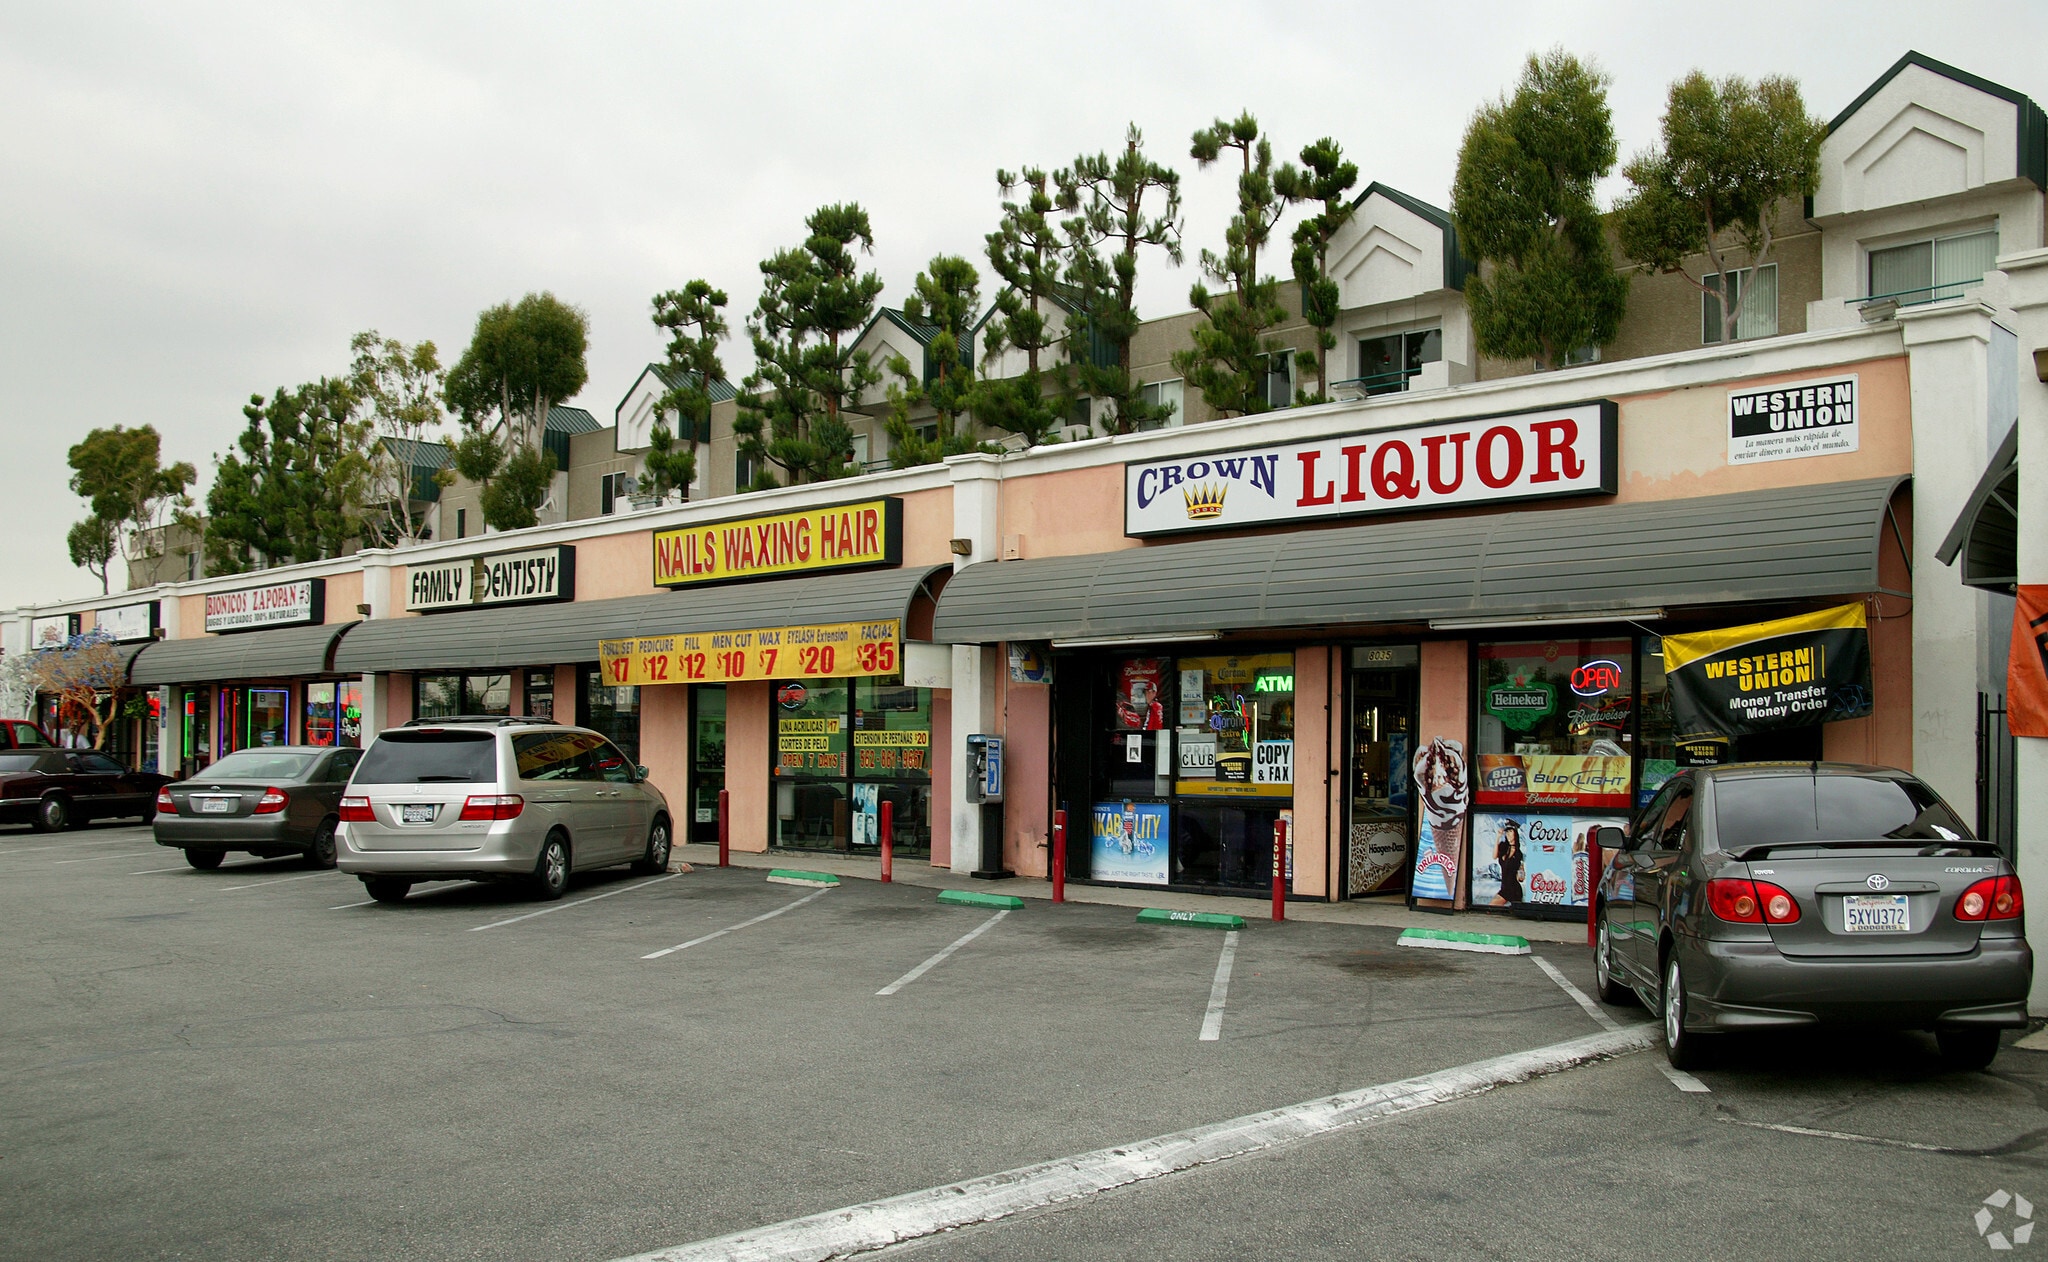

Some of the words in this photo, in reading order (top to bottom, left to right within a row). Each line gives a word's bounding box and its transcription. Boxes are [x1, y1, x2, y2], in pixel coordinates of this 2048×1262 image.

[1733, 383, 1852, 416] WESTERN
[1770, 403, 1852, 431] UNION
[1756, 437, 1784, 447] manera
[1832, 429, 1842, 439] de
[1734, 450, 1758, 460] enviar
[1760, 446, 1783, 456] dinero
[1794, 442, 1812, 454] todo
[1814, 440, 1820, 450] el
[1296, 418, 1585, 508] LIQUOR
[1137, 454, 1278, 510] CROWN
[658, 531, 715, 579] NAILS
[723, 518, 811, 568] WAXING
[820, 509, 879, 561] HAIR
[412, 568, 462, 604] FAMILY
[208, 593, 247, 616] BIONICOS
[253, 586, 297, 610] ZAPOPAN
[300, 584, 310, 604] #3
[603, 643, 619, 655] FULL
[622, 642, 634, 654] SET
[639, 638, 674, 653] PEDICURE
[685, 637, 700, 650] FILL
[712, 635, 732, 648] MEN
[735, 633, 752, 648] CUT
[760, 632, 781, 646] WAX
[788, 629, 814, 644] EYELASH
[817, 630, 848, 642] Extension
[861, 624, 893, 640] FACIAL
[608, 658, 629, 682] $17
[643, 655, 668, 680] $12
[680, 652, 706, 679] $12
[718, 651, 745, 678] $10
[760, 649, 778, 676] $7
[800, 646, 834, 674] $20
[857, 642, 894, 672] $35
[1705, 648, 1810, 679] WESTERN
[1256, 676, 1293, 692] ATM
[1571, 668, 1620, 689] OPEN
[1739, 666, 1810, 692] UNION
[1494, 694, 1544, 706] Heineken
[1730, 694, 1771, 710] Money
[1775, 686, 1827, 703] Transfer
[1568, 709, 1630, 724] Budweiser
[1746, 704, 1787, 720] Money
[1792, 698, 1828, 712] Order
[781, 738, 802, 750] CORTES
[804, 738, 812, 750] DE
[812, 738, 828, 750] PELO
[882, 732, 888, 744] DE
[914, 732, 927, 744] $20
[782, 753, 804, 768] OPEN
[809, 753, 814, 768] 7
[818, 753, 838, 768] DAYS
[1182, 754, 1214, 766] CLUB
[1187, 744, 1211, 757] PRO
[1257, 744, 1290, 765] COPY
[1258, 770, 1264, 781] &
[1269, 766, 1289, 782] FAX
[1490, 776, 1522, 788] LIGHT
[1493, 768, 1518, 778] BUD
[1533, 774, 1569, 784] BUD
[1576, 776, 1626, 786] LIGHT
[1525, 792, 1578, 804] Budweiser
[1530, 820, 1568, 842] Coors
[1417, 854, 1456, 877] DRUMSTICK
[1531, 872, 1568, 893] Coors
[1532, 892, 1564, 904] LIGHT
[1170, 912, 1196, 920] ONLY
[1849, 908, 1904, 924] 5XYU372
